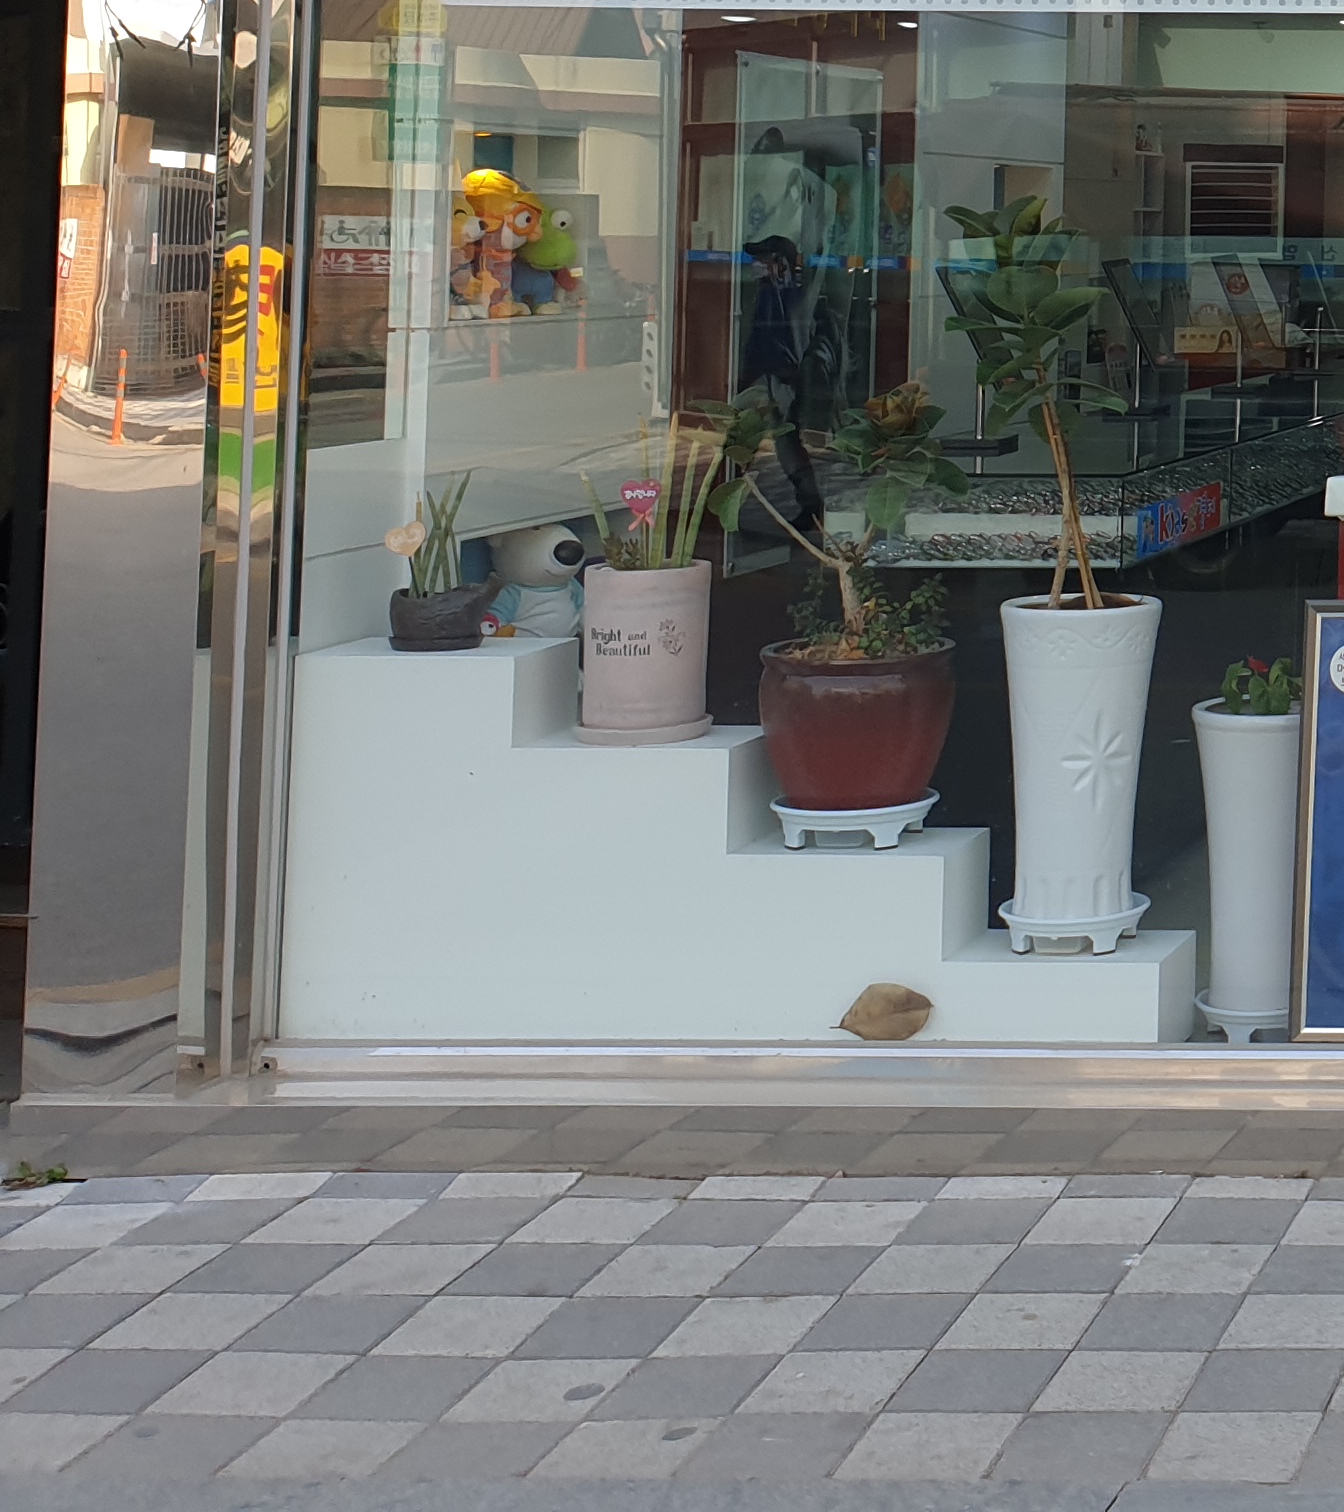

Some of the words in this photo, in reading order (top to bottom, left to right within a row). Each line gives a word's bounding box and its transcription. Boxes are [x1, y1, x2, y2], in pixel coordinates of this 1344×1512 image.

[590, 627, 622, 645] Bright
[627, 630, 648, 641] and
[595, 643, 651, 657] Beautiful
